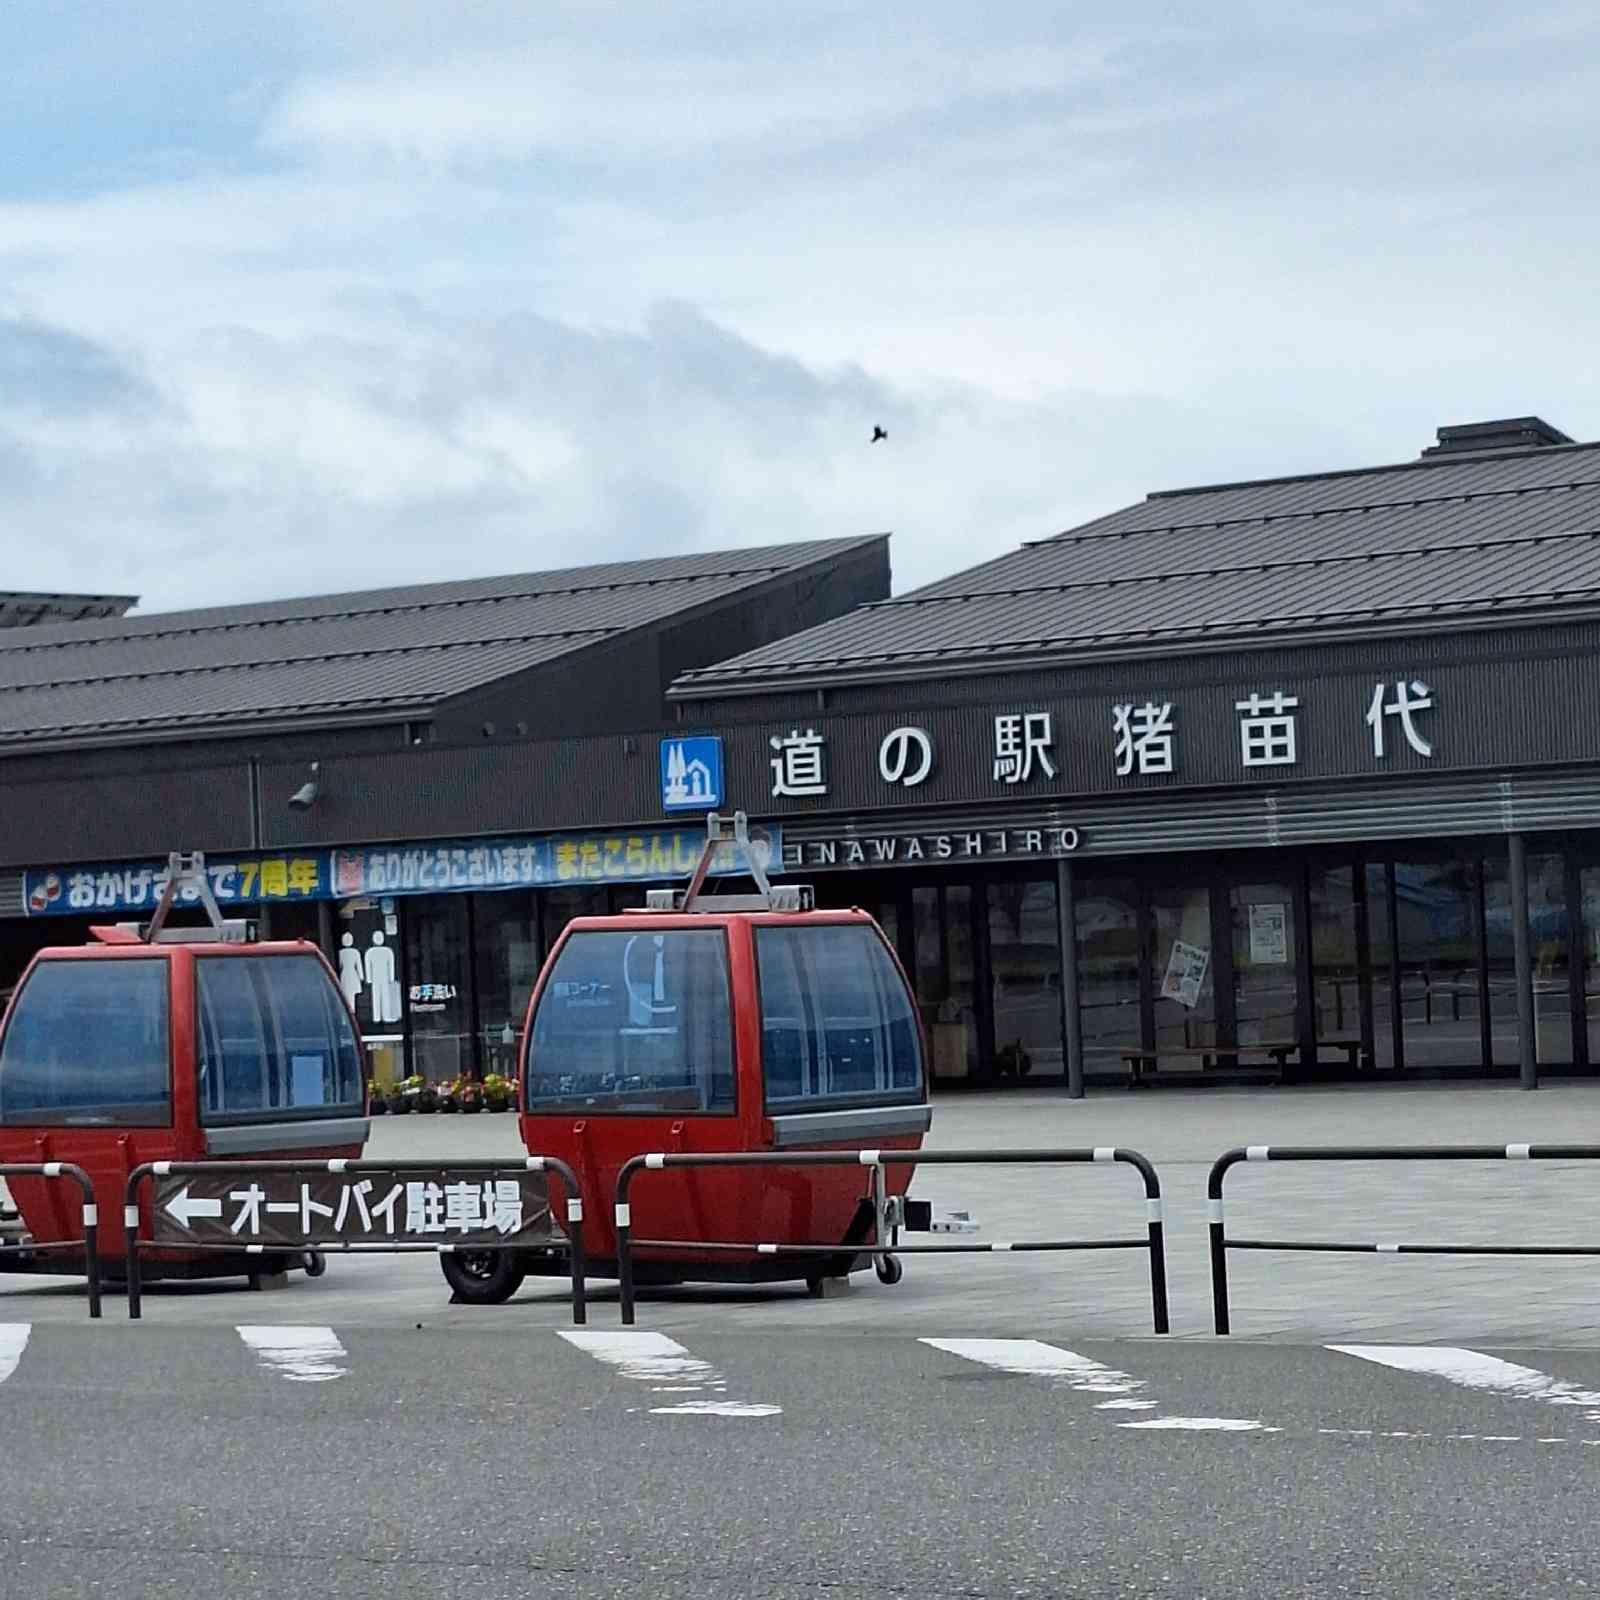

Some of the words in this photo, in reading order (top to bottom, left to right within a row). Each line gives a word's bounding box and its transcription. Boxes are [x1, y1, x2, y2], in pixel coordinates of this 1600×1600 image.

[769, 680, 1434, 798] 道の駅猪苗代
[796, 828, 1078, 864] INAWASHIRO
[230, 1179, 523, 1236] オートバイ駐車場
